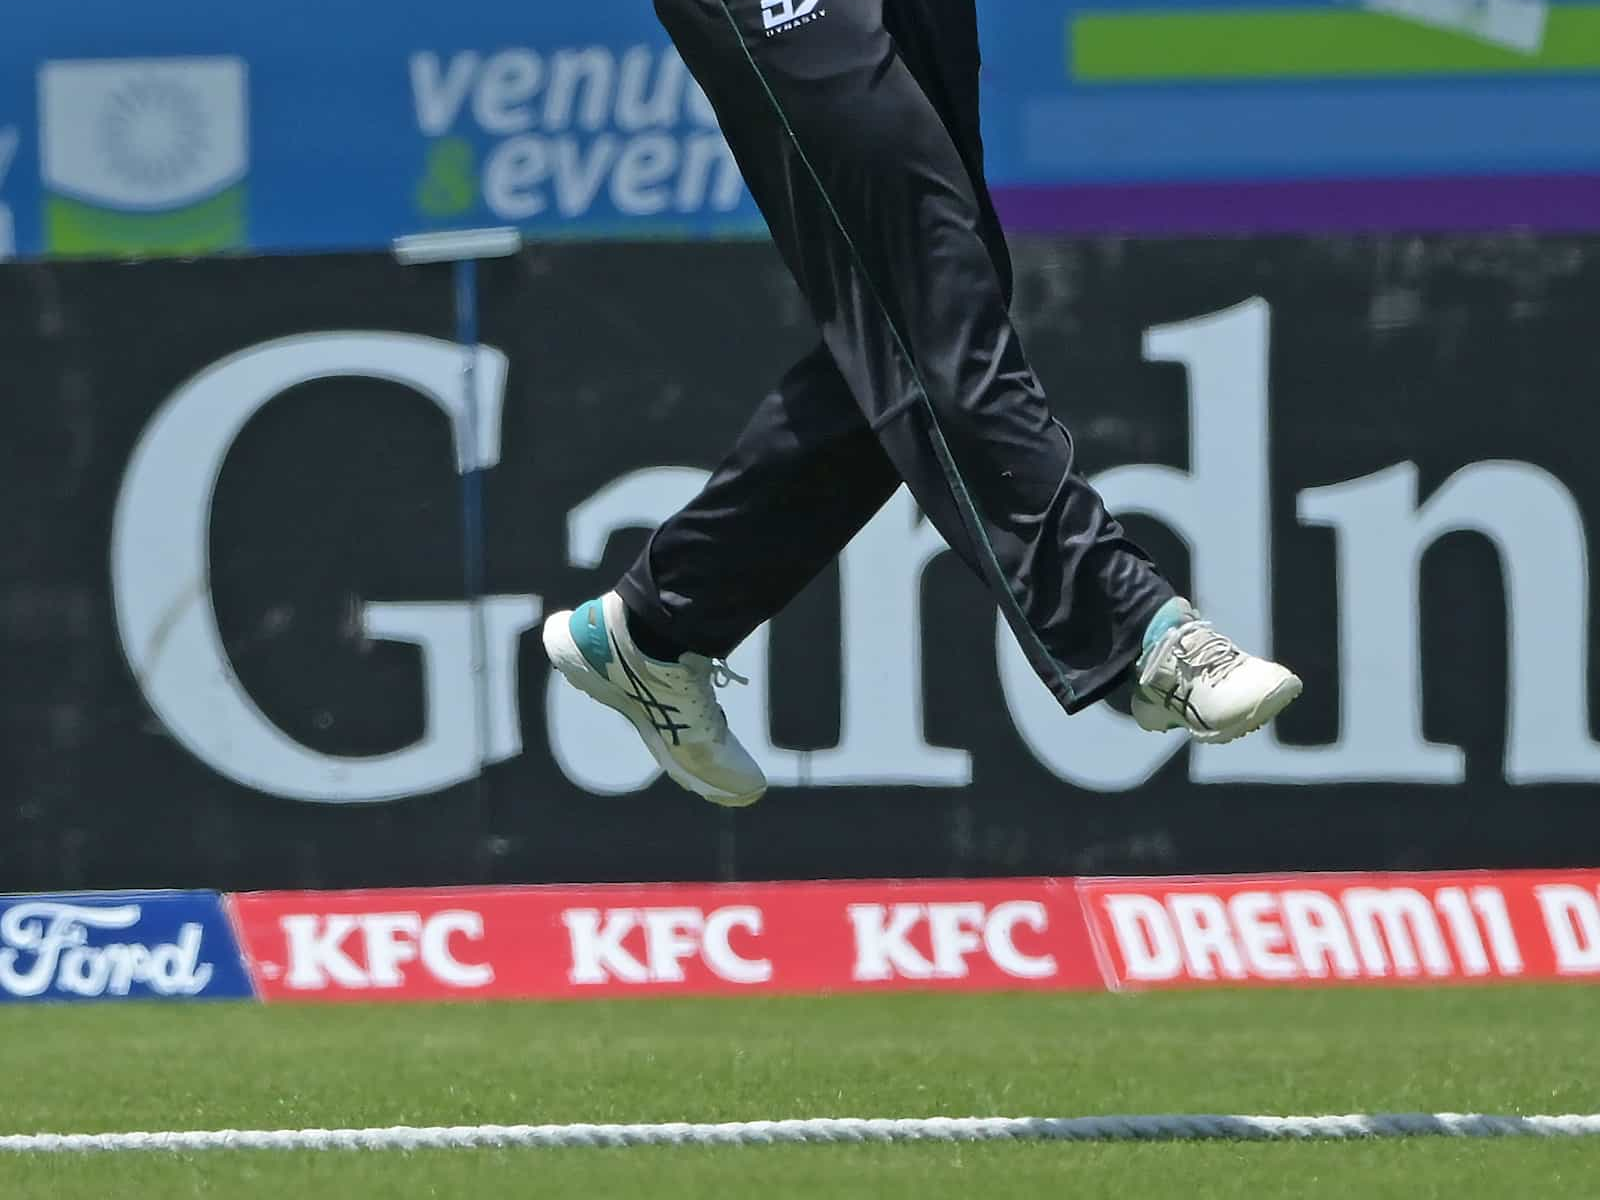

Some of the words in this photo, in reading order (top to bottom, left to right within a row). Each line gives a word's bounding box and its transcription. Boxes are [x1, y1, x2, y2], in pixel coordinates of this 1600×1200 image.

[0, 902, 213, 996] Ford
[280, 908, 494, 989] KFC
[560, 904, 773, 985] KFC
[847, 899, 1058, 983] KFC
[1102, 885, 1524, 981] DREAM11
[1533, 882, 1600, 976] D
